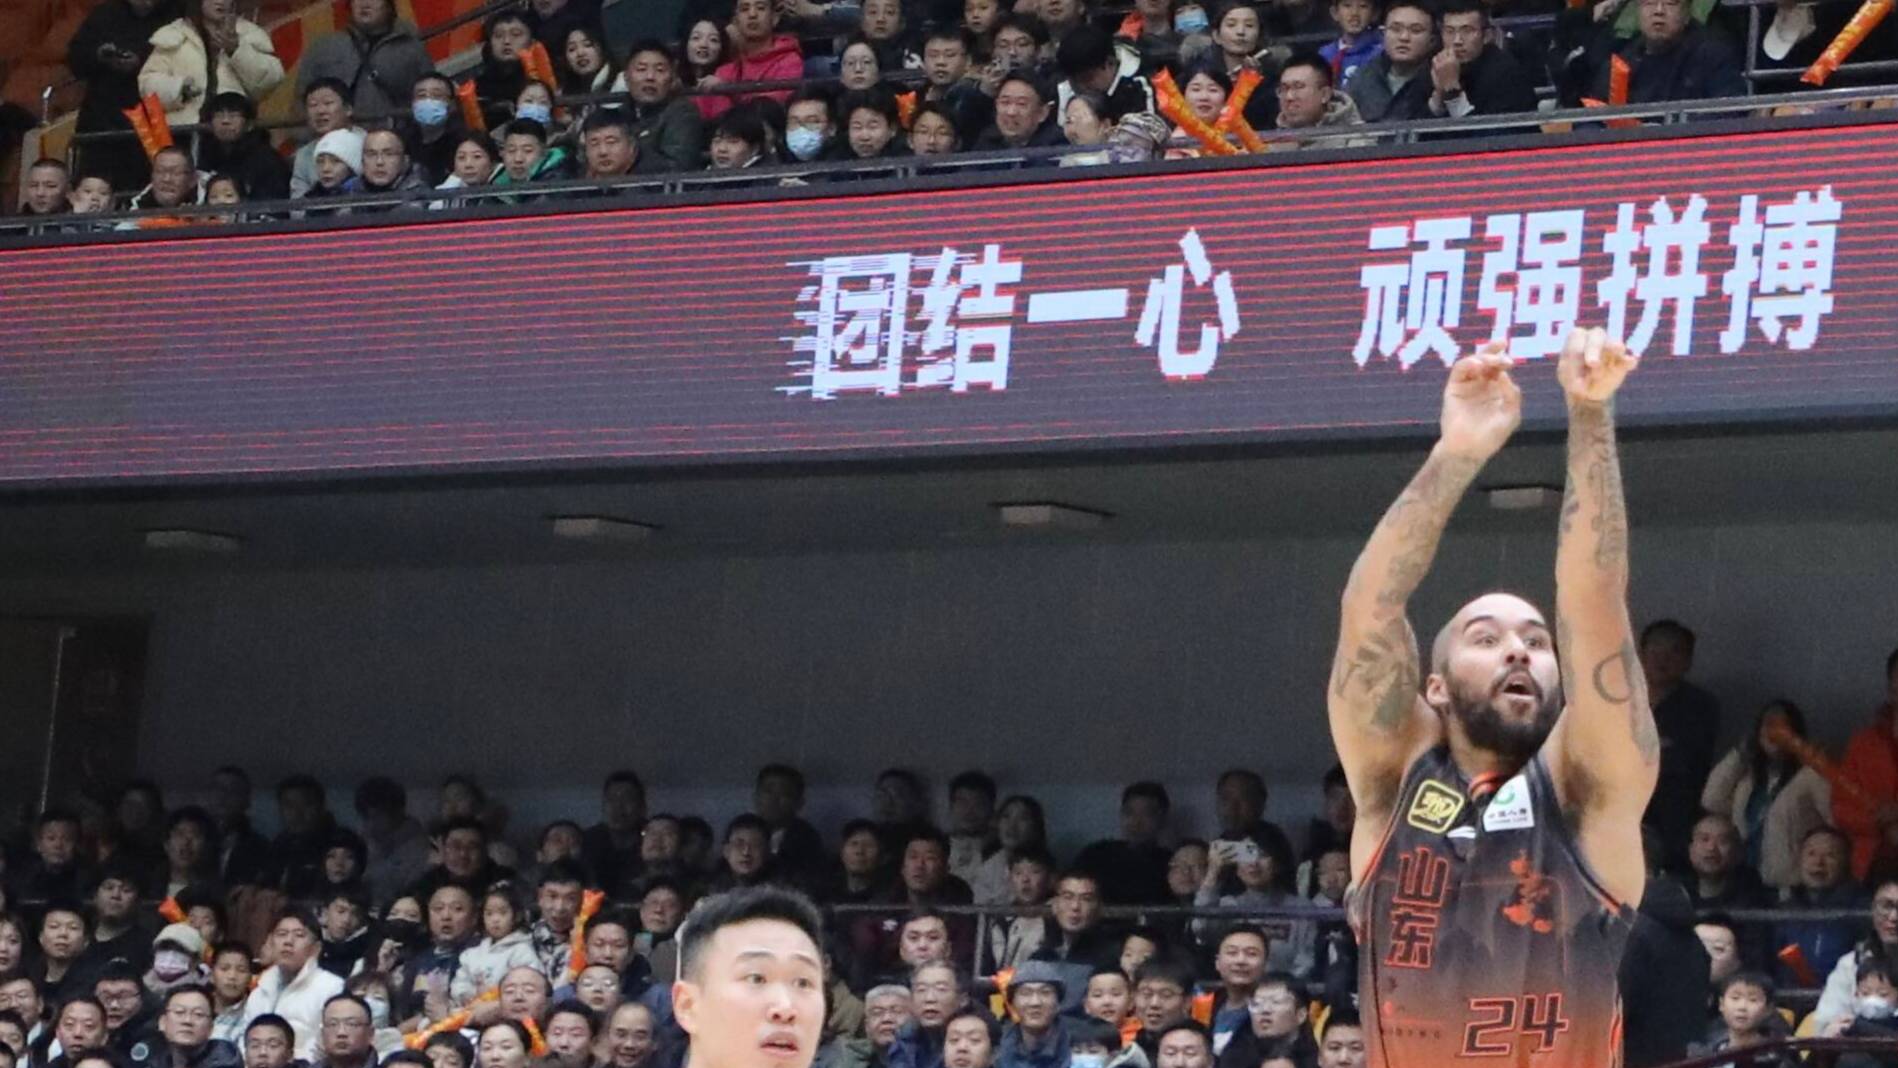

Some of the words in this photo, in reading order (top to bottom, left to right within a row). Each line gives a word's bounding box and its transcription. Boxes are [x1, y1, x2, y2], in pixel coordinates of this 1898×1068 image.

[782, 228, 1241, 399] 团结一心
[1352, 183, 1842, 370] 顽强拼搏
[1384, 846, 1450, 969] 山东
[1460, 992, 1571, 1057] 24
